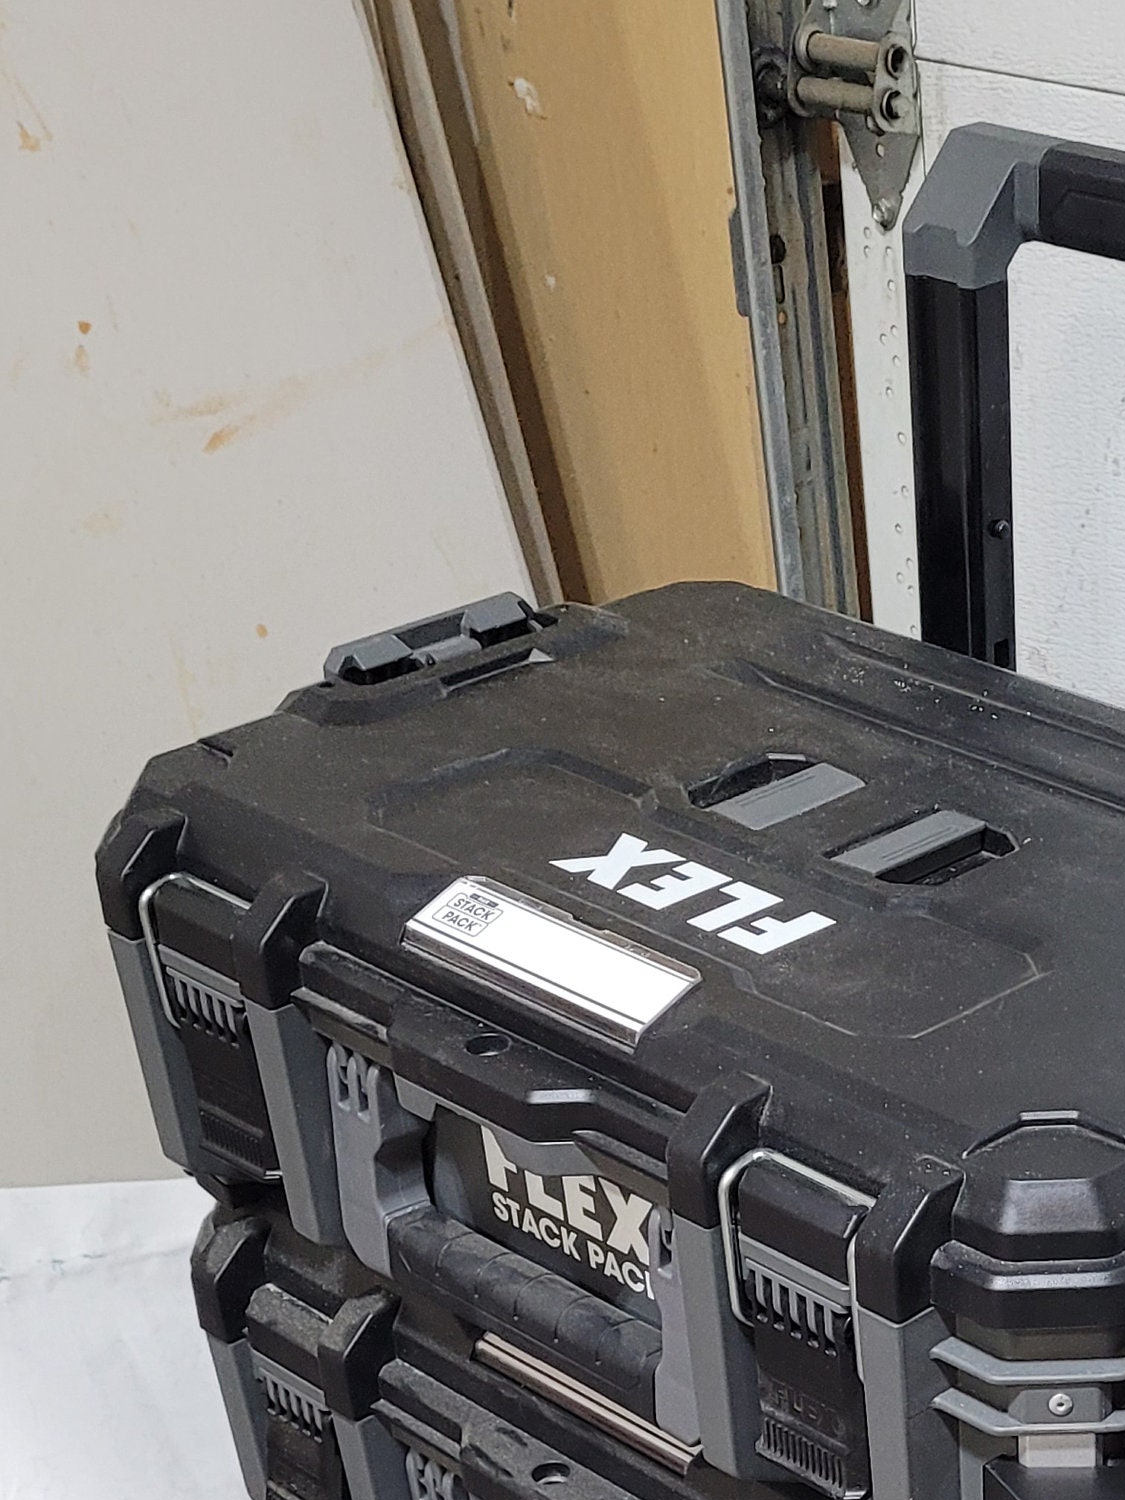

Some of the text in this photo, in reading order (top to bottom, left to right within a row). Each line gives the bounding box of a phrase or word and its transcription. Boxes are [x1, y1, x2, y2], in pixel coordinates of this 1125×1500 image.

[453, 898, 496, 921] STACK
[548, 832, 838, 955] FLEX
[441, 910, 480, 932] PACK
[492, 1191, 582, 1262] STACK
